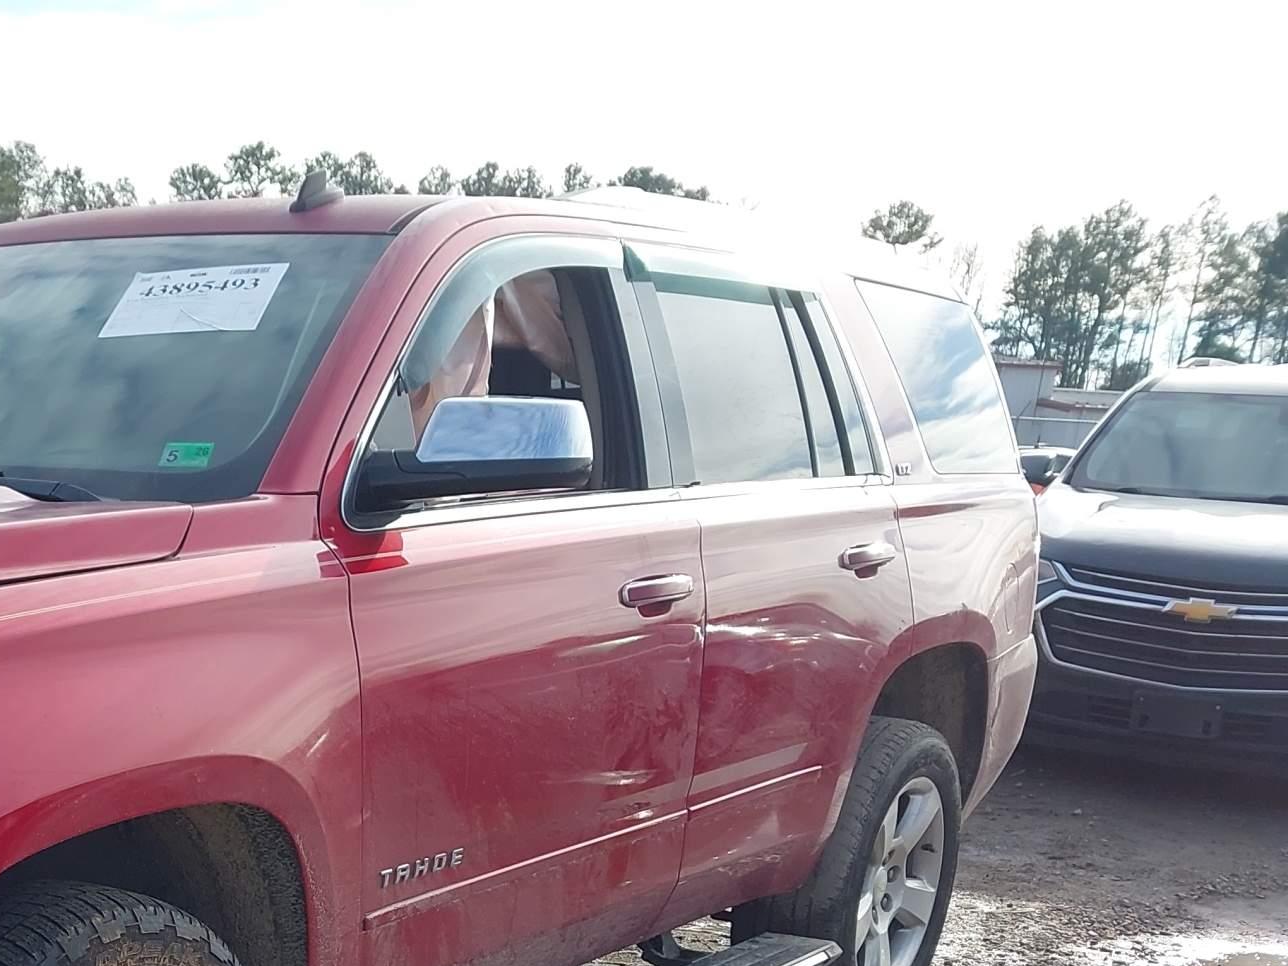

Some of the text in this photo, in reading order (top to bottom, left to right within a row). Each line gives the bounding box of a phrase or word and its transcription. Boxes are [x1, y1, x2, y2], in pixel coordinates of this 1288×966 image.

[139, 278, 260, 297] 43895493
[166, 449, 179, 463] 5
[380, 847, 464, 888] TAHOE
